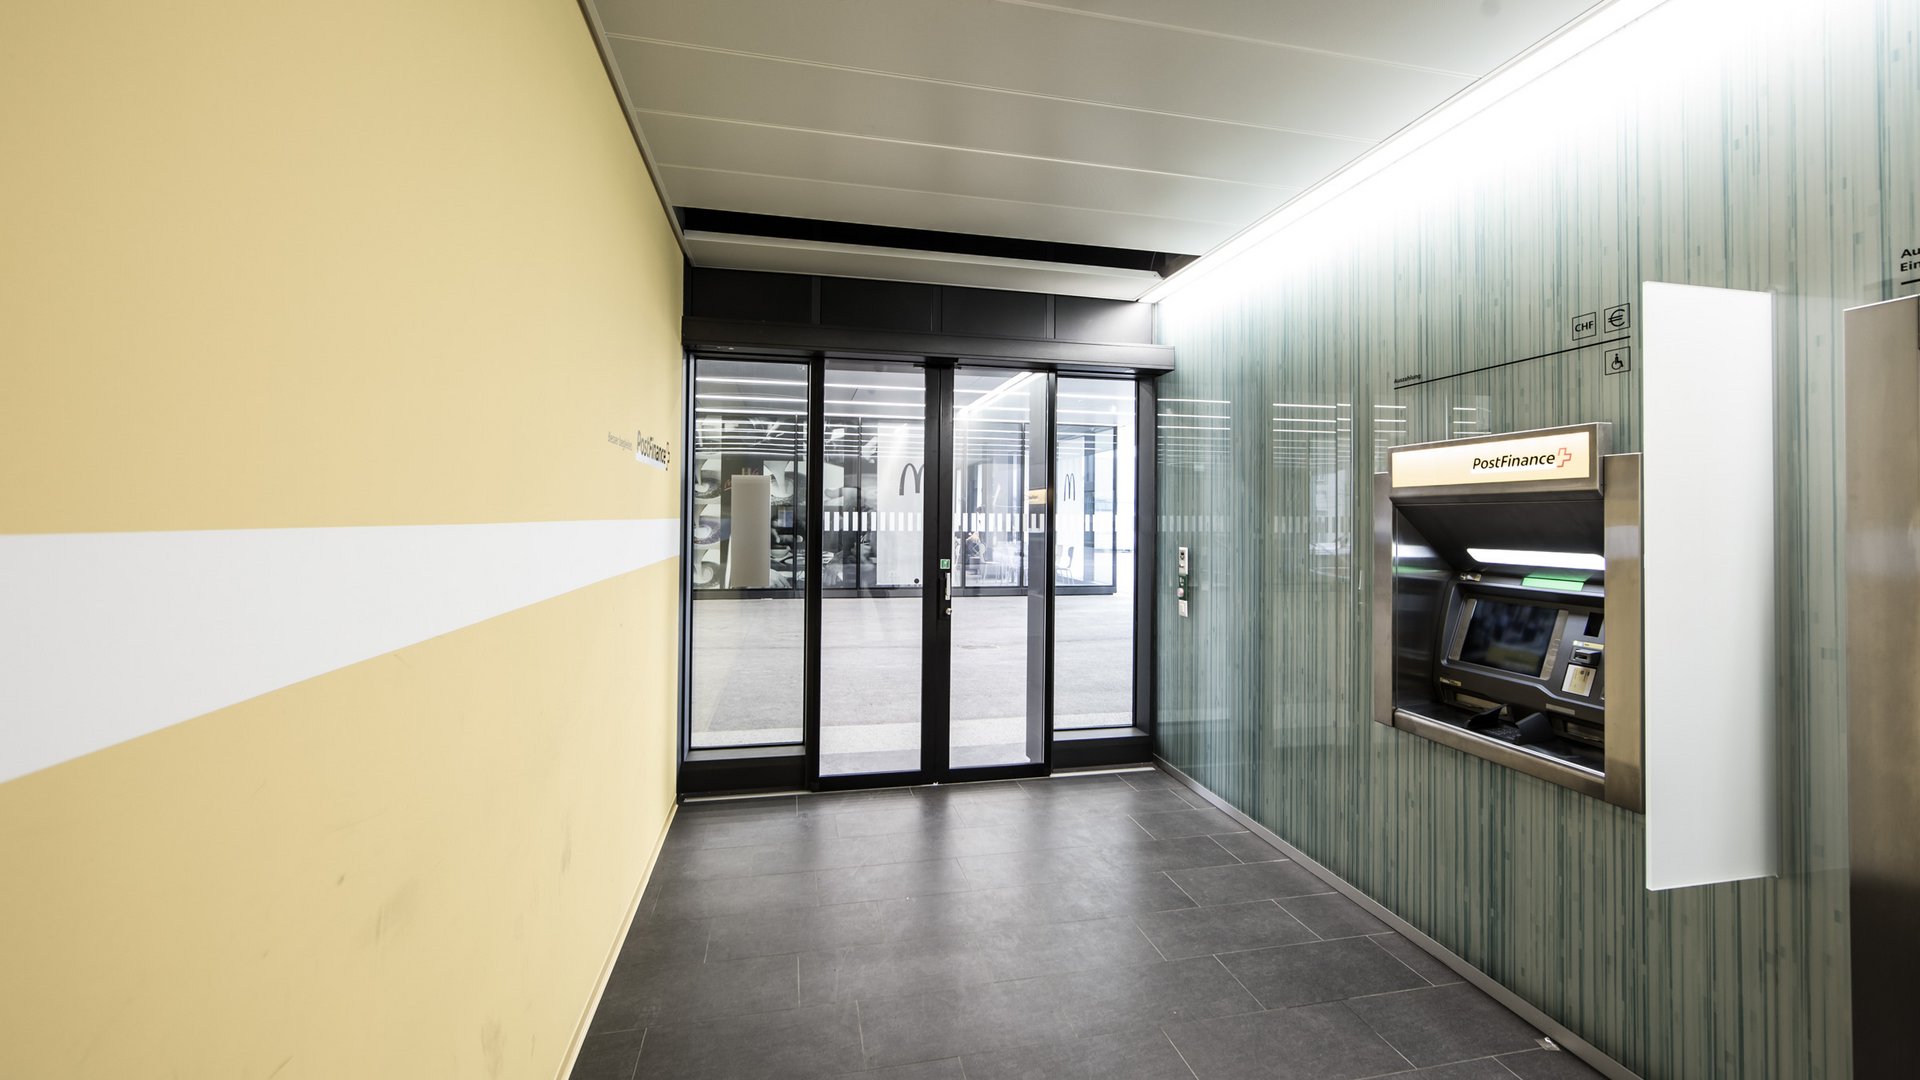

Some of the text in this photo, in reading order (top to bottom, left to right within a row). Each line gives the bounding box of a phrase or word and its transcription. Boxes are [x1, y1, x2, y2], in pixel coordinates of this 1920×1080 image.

[1575, 321, 1594, 332] CHF
[1394, 373, 1421, 384] Auszahlung
[637, 430, 666, 465] PostFinance
[1472, 454, 1556, 470] PostFinance
